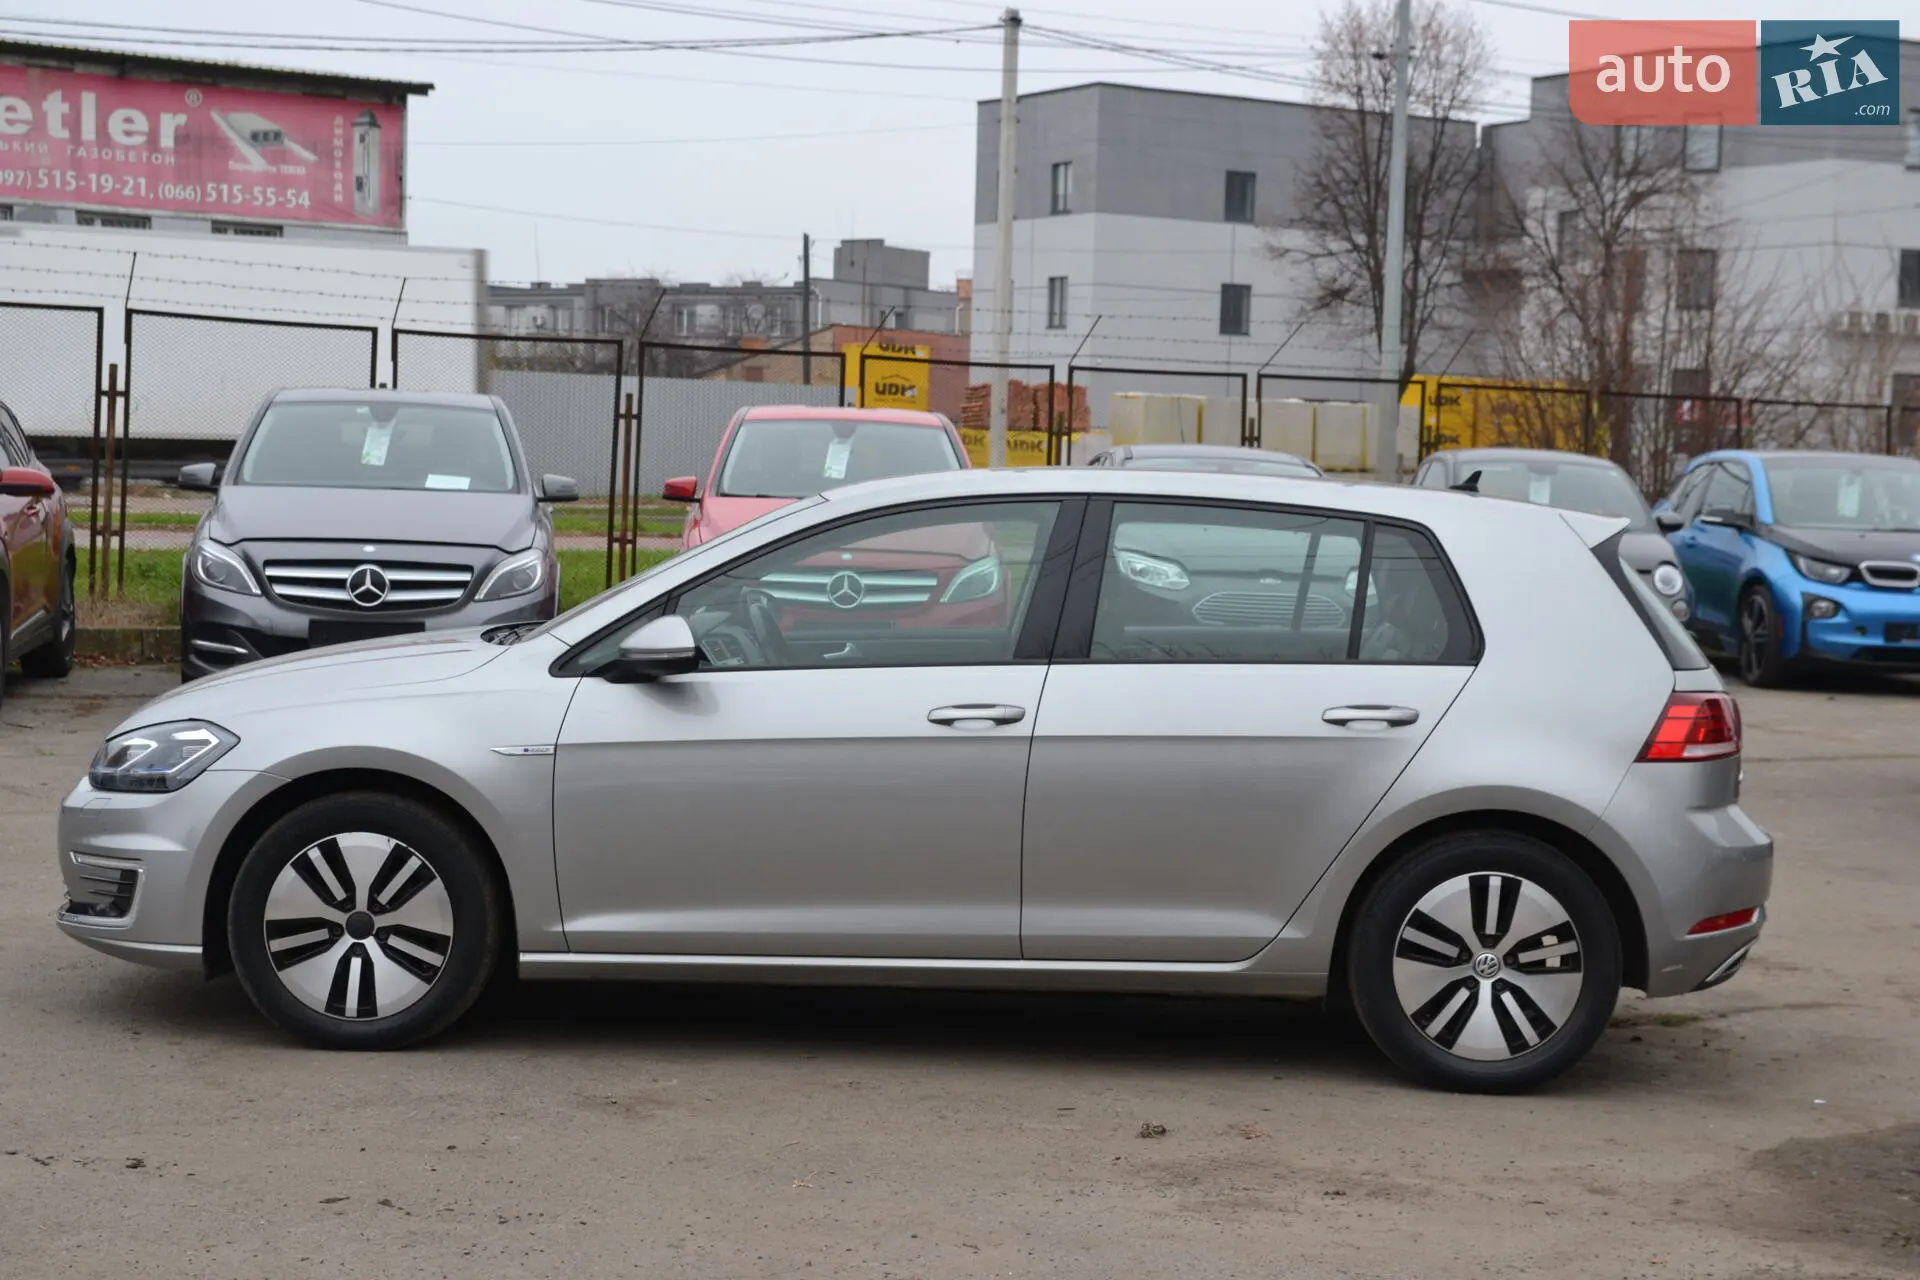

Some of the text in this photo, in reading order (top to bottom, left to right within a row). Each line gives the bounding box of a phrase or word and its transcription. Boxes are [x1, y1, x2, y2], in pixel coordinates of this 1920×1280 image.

[0, 89, 187, 148] etler
[66, 145, 176, 166] ГАЗОБЕТОН
[37, 168, 155, 199] 515-19-21,
[158, 183, 201, 203] (066)
[205, 182, 312, 209] 515-55-54
[875, 381, 917, 398] UDK
[961, 433, 985, 446] DK
